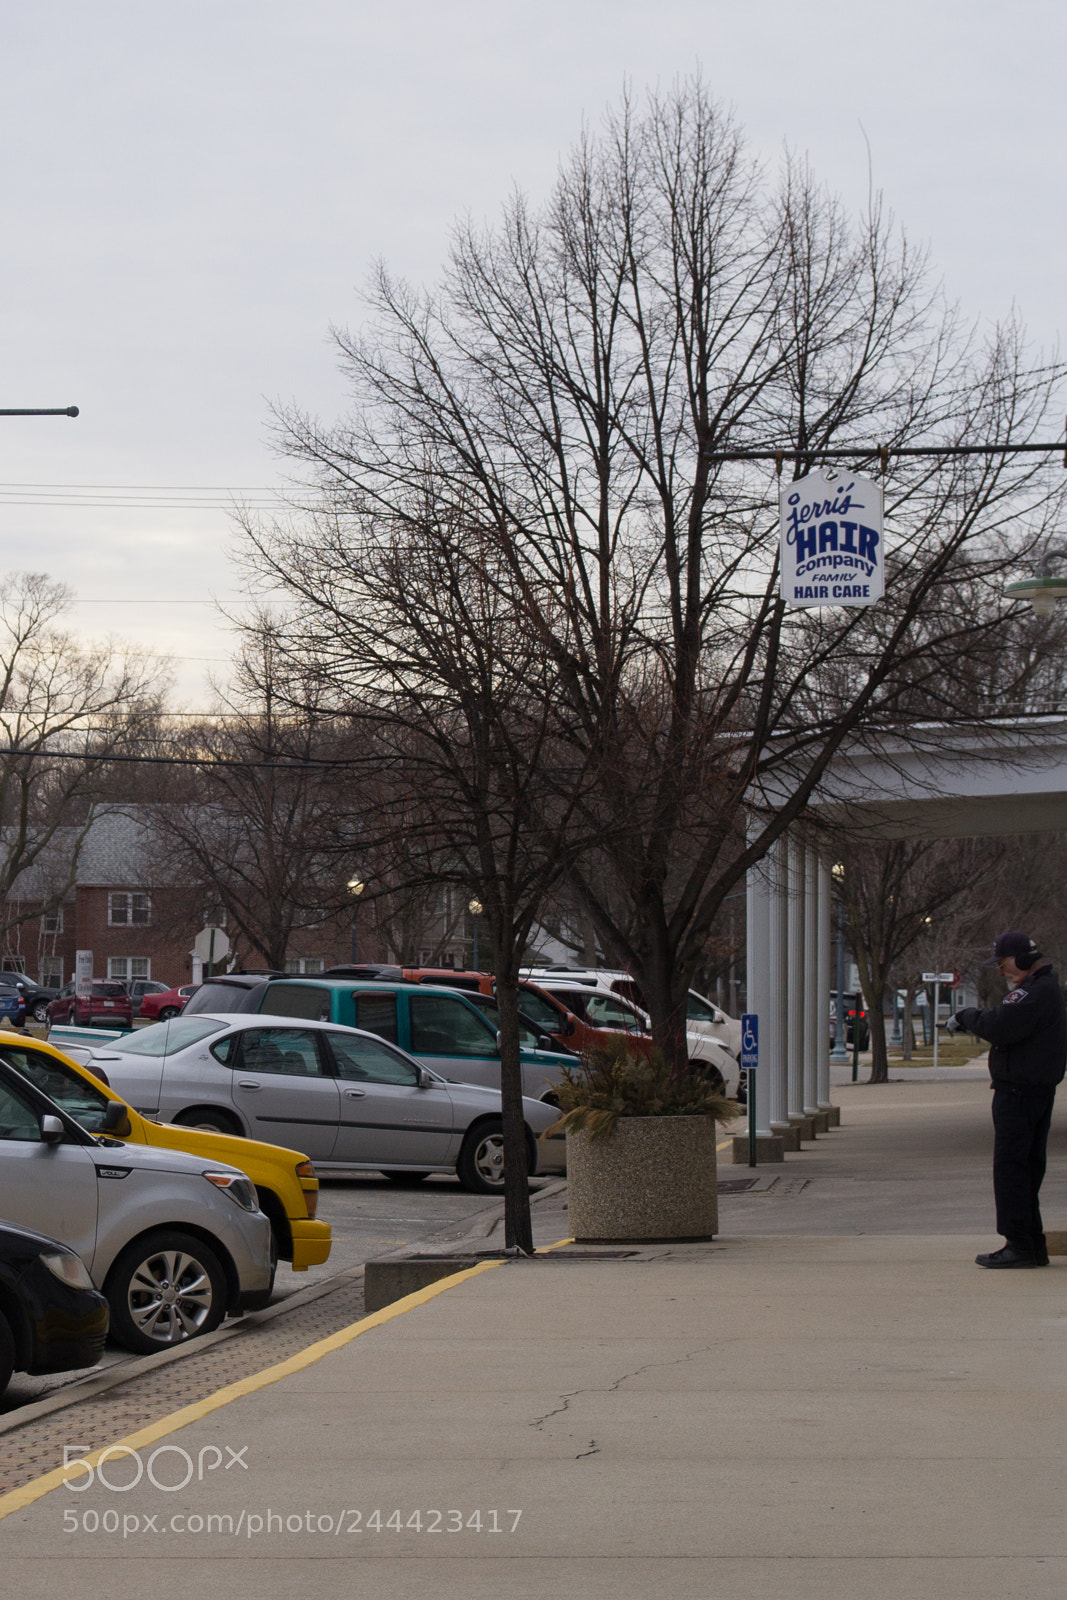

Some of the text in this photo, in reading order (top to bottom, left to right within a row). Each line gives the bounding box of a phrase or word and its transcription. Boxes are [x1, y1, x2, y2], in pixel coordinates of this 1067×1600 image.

[786, 482, 865, 545] jerri's
[796, 521, 879, 566] HAIR
[796, 555, 874, 577] company
[812, 573, 857, 582] FAMILY
[794, 585, 870, 599] HAIR CARE
